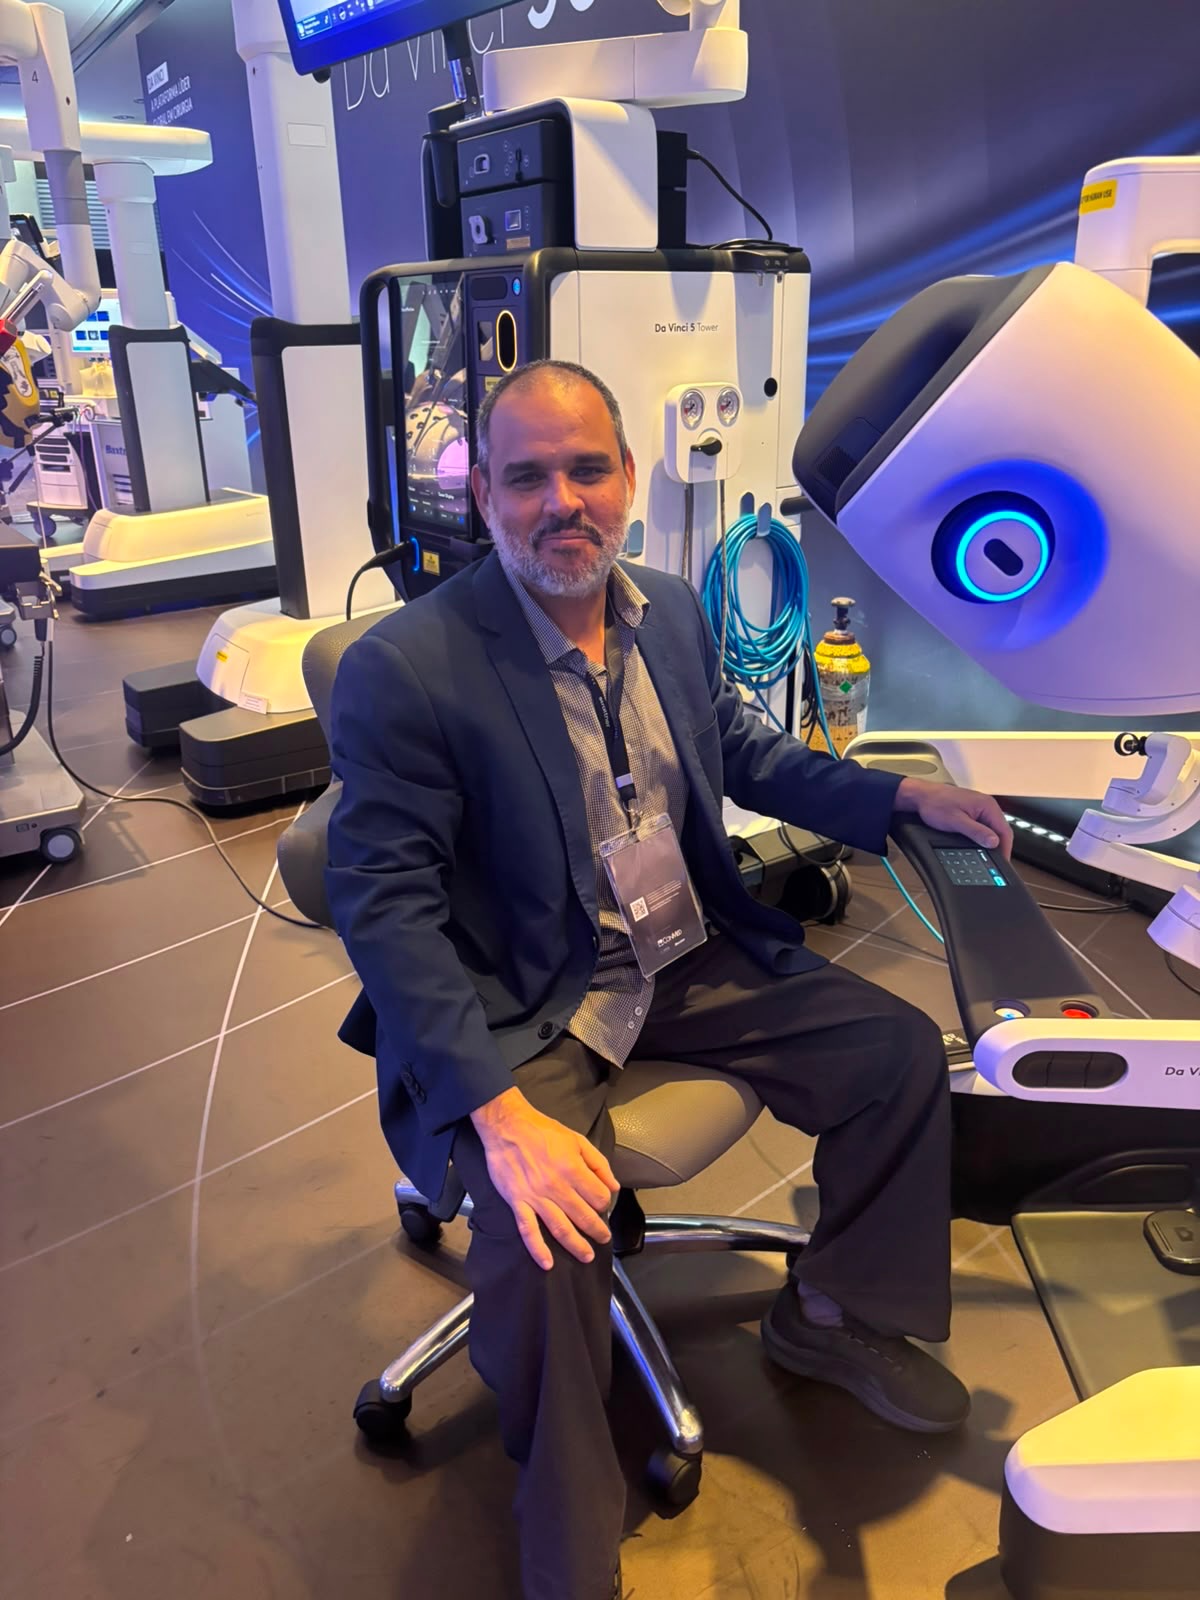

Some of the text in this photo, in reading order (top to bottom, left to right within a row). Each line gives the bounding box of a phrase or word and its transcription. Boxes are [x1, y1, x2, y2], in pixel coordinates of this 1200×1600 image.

[31, 70, 39, 84] 4
[1103, 189, 1112, 198] USE
[655, 322, 719, 332] Da Vinci 5 Tower
[1165, 1066, 1200, 1076] Da V
